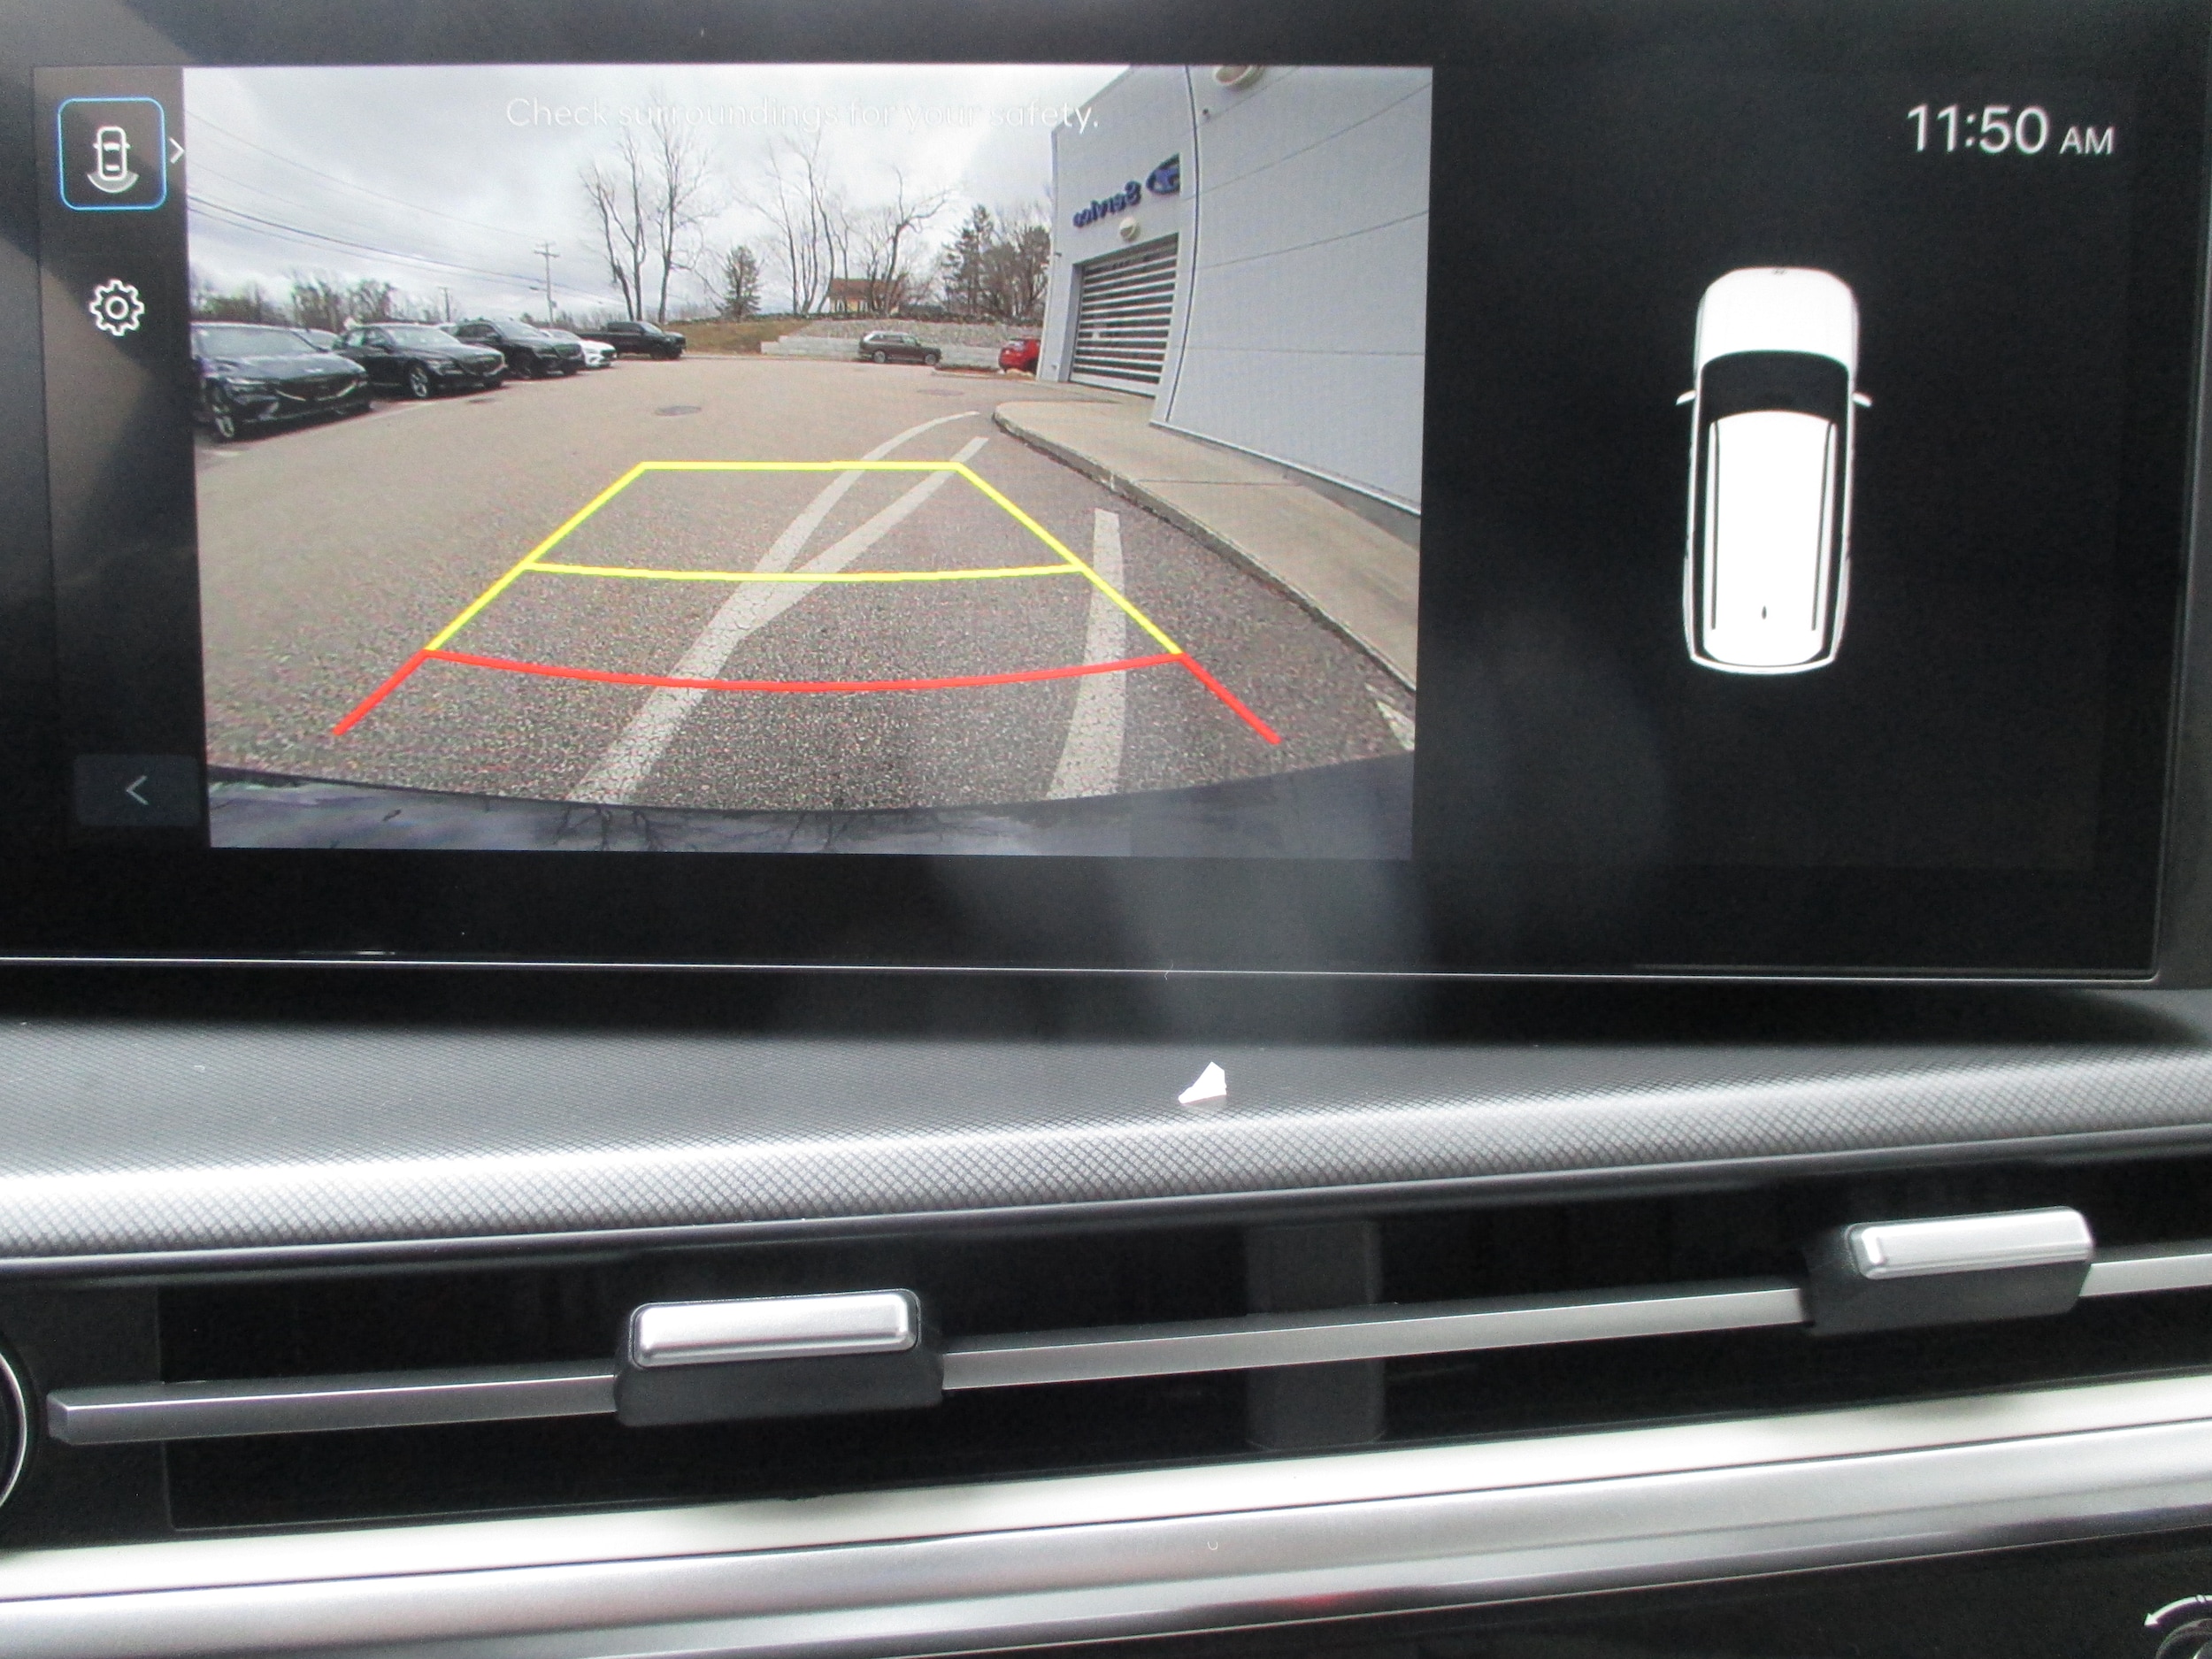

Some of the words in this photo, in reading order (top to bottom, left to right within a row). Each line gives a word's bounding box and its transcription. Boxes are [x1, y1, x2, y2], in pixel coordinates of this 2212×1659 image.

[505, 96, 608, 127] Check
[618, 96, 839, 132] surroundings
[849, 98, 896, 127] for
[905, 103, 979, 133] your
[989, 100, 1099, 134] safety.
[1907, 104, 2049, 154] 11:50
[2059, 126, 2116, 155] AM
